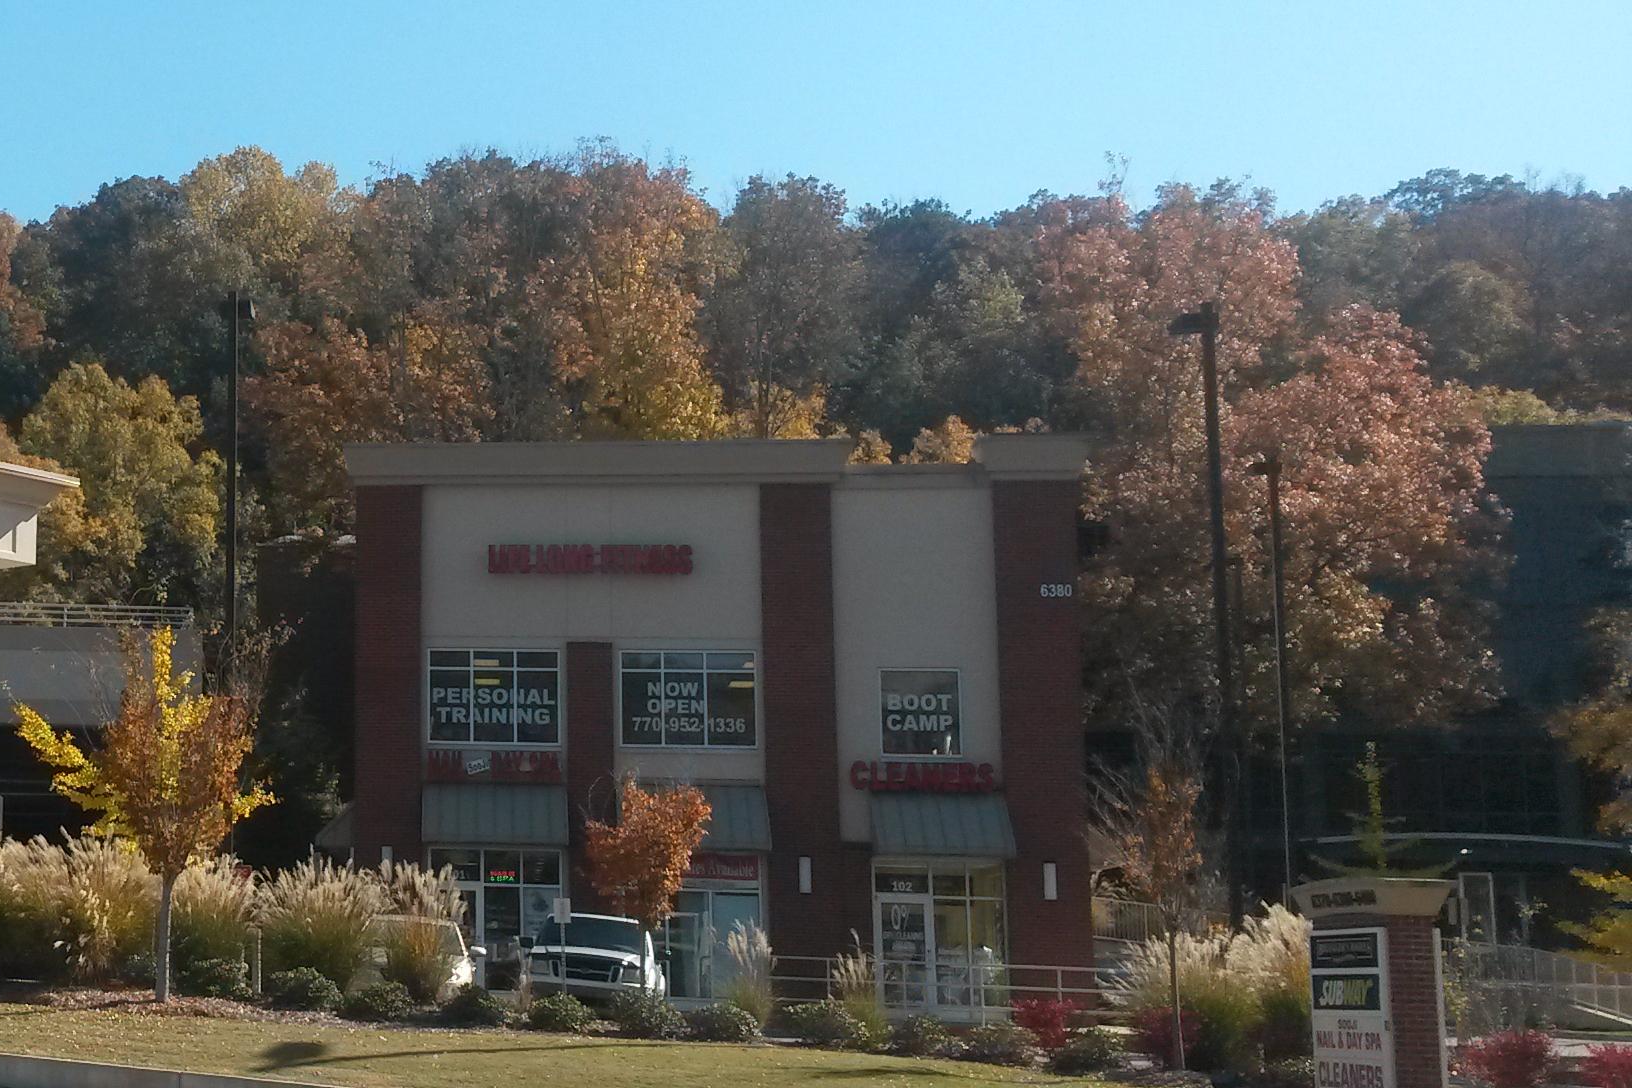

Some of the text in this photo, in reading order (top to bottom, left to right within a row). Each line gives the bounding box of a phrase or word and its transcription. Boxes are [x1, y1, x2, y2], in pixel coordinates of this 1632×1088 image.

[1040, 583, 1073, 598] 6380
[432, 687, 556, 705] PERSONAL
[648, 682, 698, 697] NOW
[648, 699, 704, 714] OPEN
[887, 694, 952, 711] BOOT
[436, 707, 551, 725] TRAINING
[887, 714, 953, 731] CAMP
[632, 717, 746, 733] 770-952-1336
[850, 760, 994, 793] CLEANERS
[891, 881, 913, 892] 102
[1319, 980, 1374, 1006] SUBWAY
[1316, 1031, 1336, 1049] NAIL
[1347, 1032, 1362, 1050] DAY
[1365, 1032, 1382, 1052] SPA
[1319, 1061, 1384, 1088] CLEANERS
